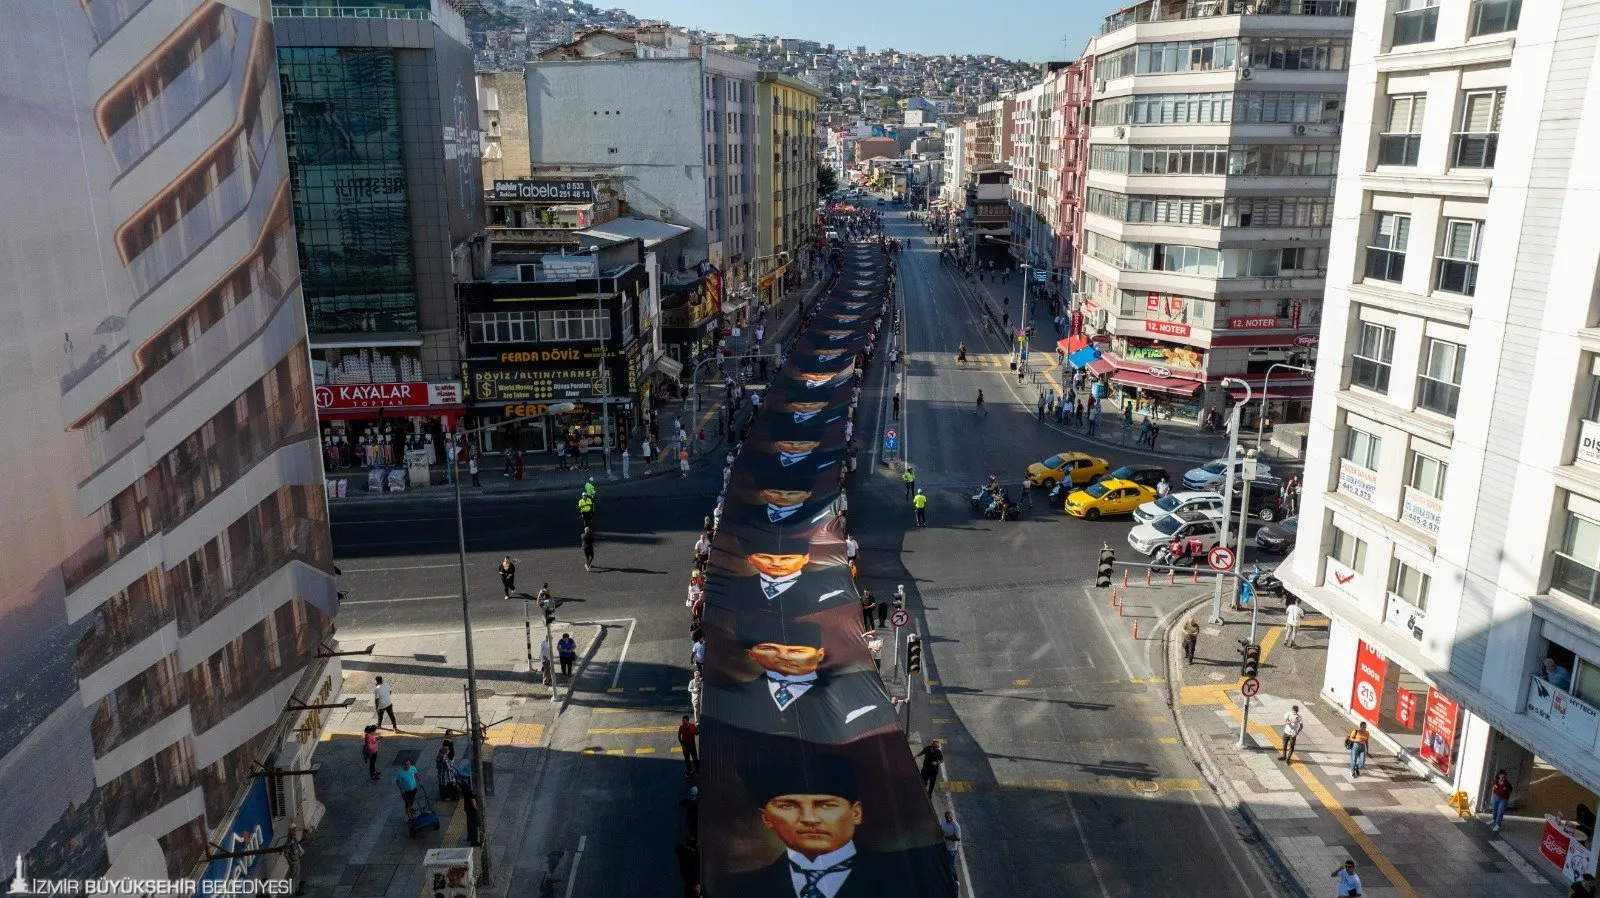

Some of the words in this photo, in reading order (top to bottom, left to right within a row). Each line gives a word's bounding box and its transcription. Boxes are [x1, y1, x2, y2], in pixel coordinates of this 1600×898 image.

[518, 183, 558, 198] Tabela
[572, 182, 584, 190] 533
[559, 190, 571, 198] 251
[572, 190, 581, 198] 48
[582, 190, 590, 198] 13
[1147, 322, 1158, 331] 12.
[1159, 323, 1187, 335] NOTER
[1245, 318, 1275, 327] NOTER
[501, 352, 539, 363] FERDA
[541, 348, 580, 361] DÖVİZ
[461, 362, 470, 396] ALTIN
[476, 371, 511, 380] DÖVİZ
[556, 369, 611, 378] TRANSFR
[340, 384, 411, 400] KAYALAR
[505, 403, 549, 417] FERD
[1361, 685, 1374, 702] 215
[1569, 699, 1597, 717] HYTECH
